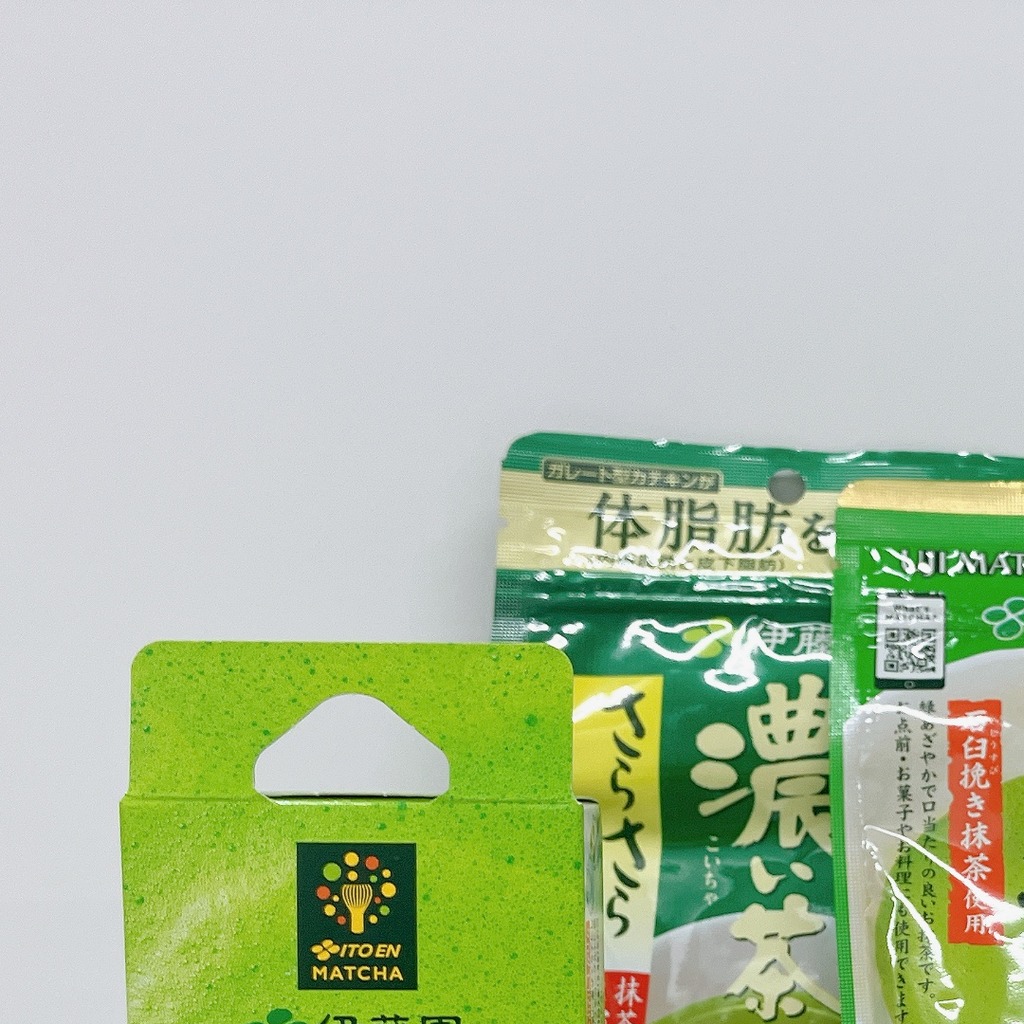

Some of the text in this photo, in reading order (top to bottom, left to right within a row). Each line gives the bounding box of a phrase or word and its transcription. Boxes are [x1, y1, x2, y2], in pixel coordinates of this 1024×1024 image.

[601, 691, 647, 938] さらさら
[689, 673, 841, 1022] 濃い茶
[312, 965, 405, 981] MATCHA
[340, 943, 402, 958] ITO EN
